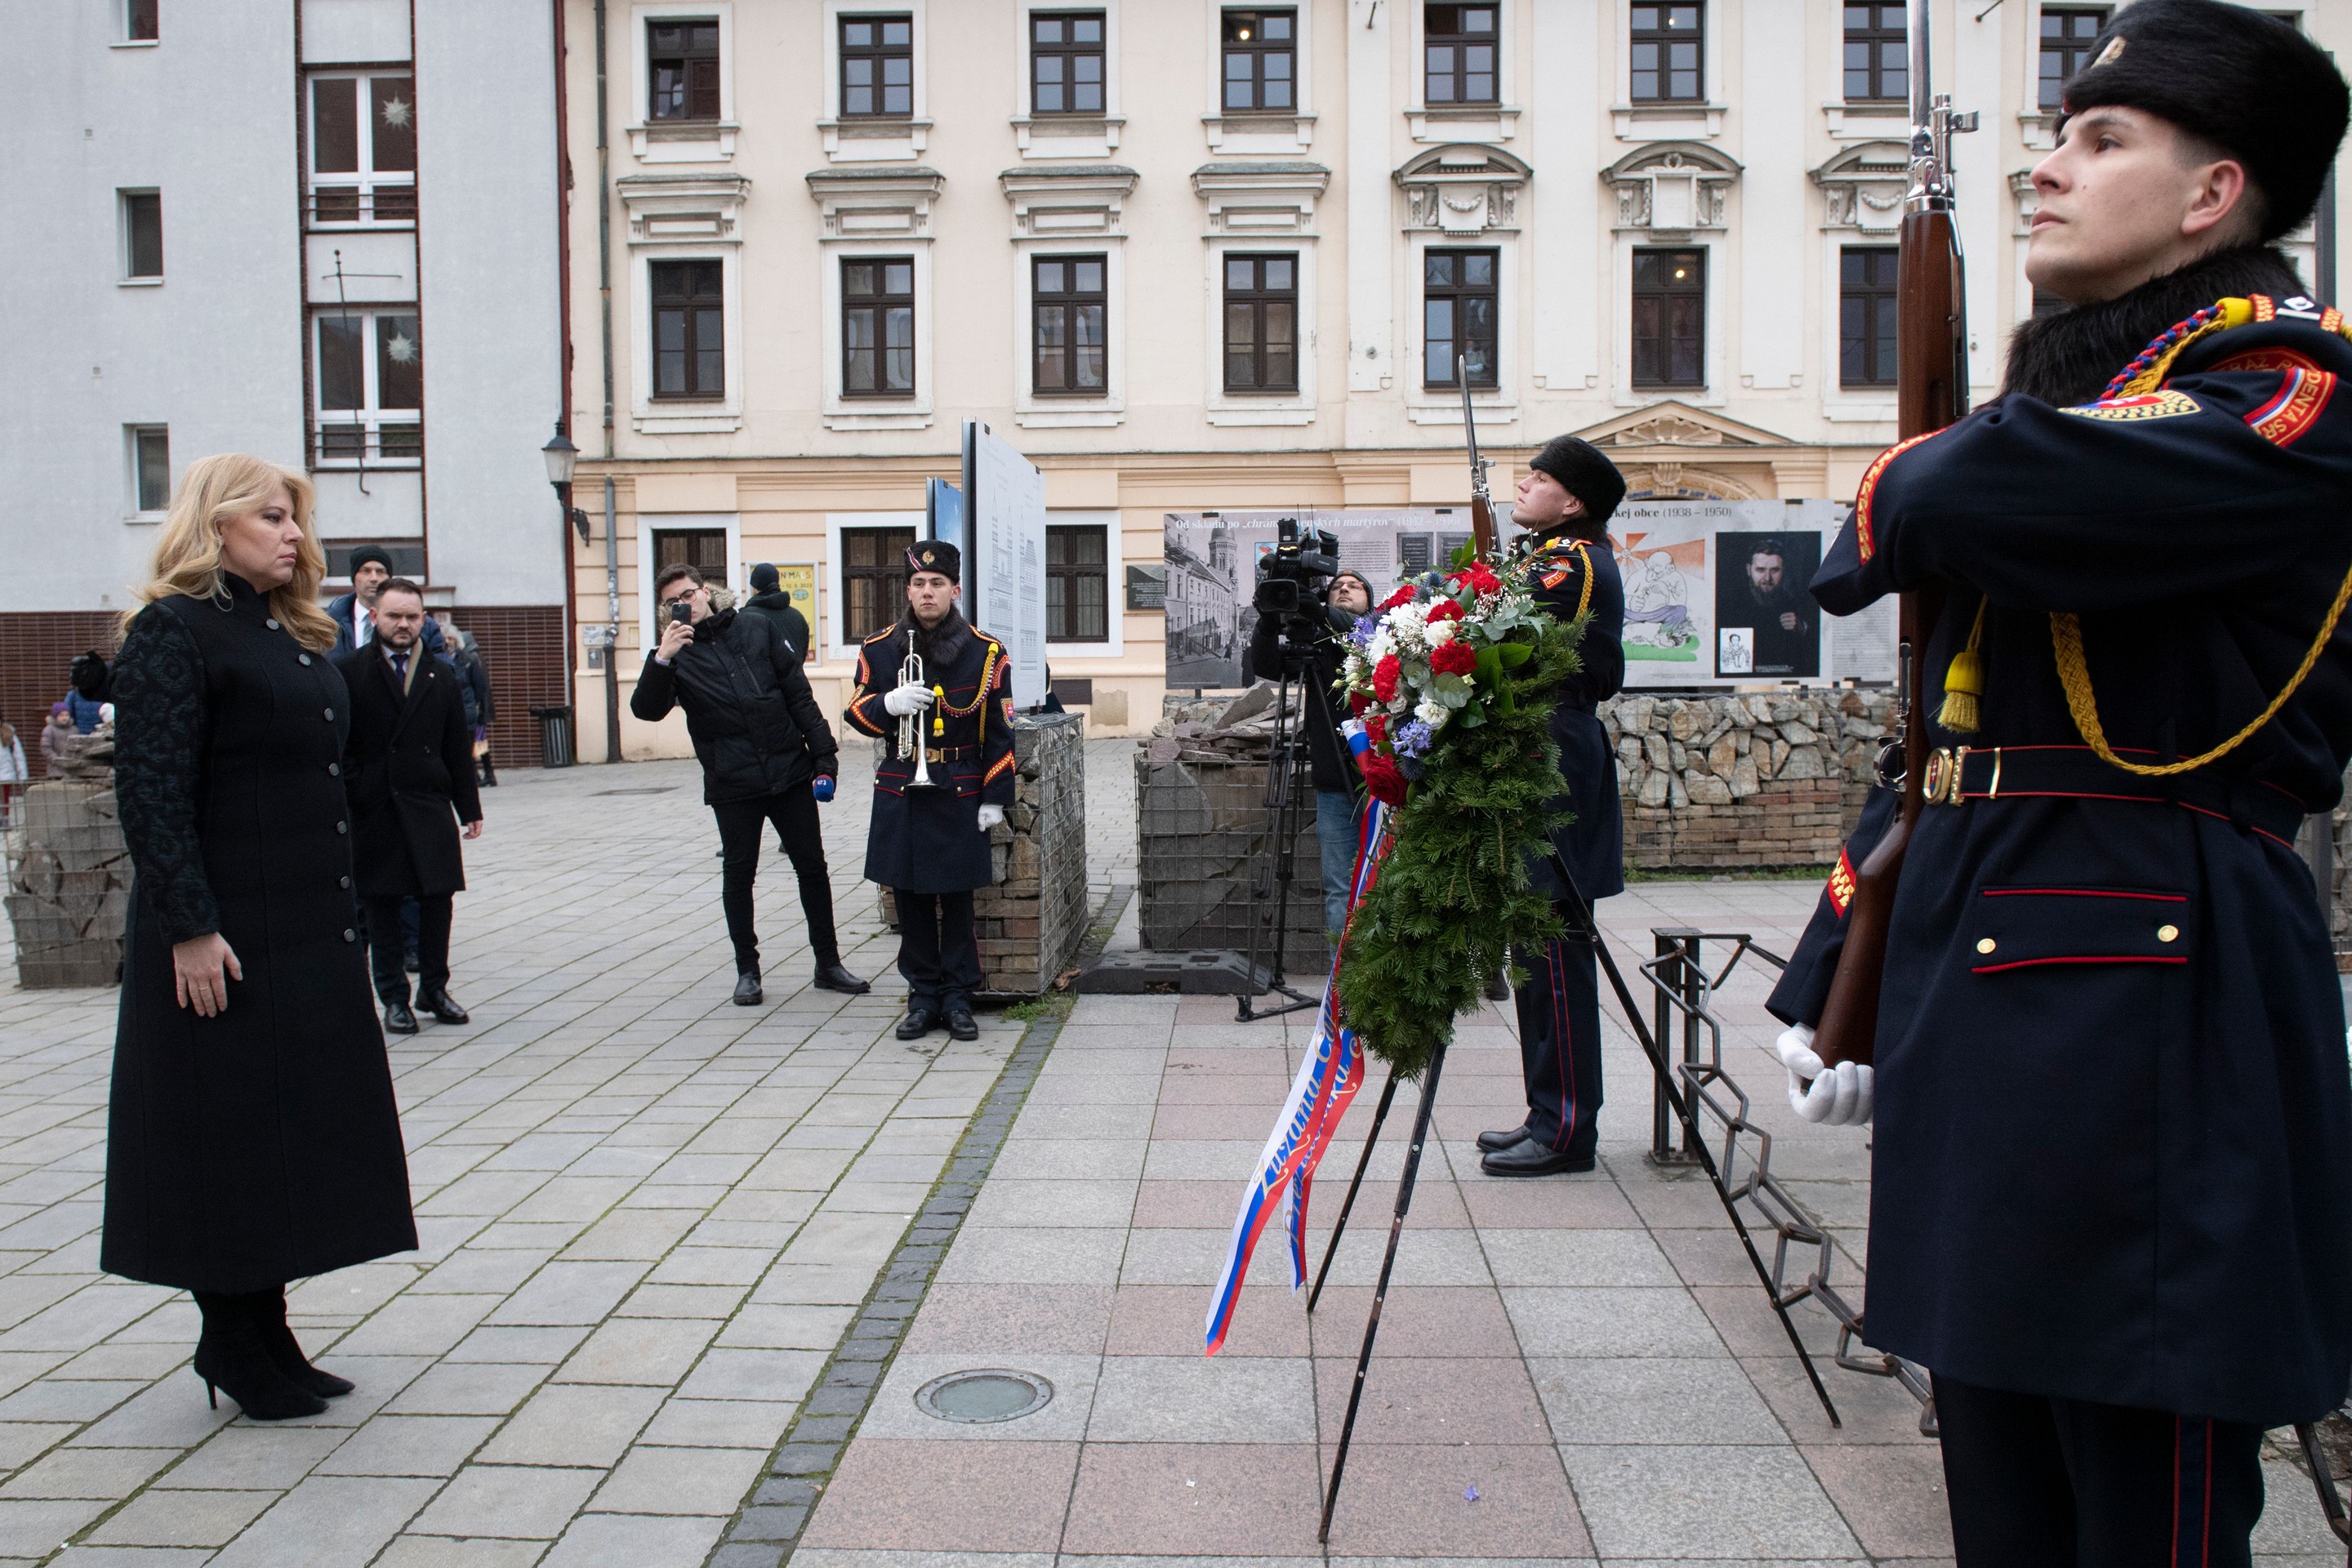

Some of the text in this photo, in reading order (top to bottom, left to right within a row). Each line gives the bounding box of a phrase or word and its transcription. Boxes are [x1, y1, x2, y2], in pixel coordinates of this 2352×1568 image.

[2261, 418, 2287, 439] SR
[1615, 508, 1631, 519] kej
[1634, 508, 1659, 517] obce
[1663, 507, 1691, 518] (1938
[1704, 507, 1732, 518] 1950)
[1175, 519, 1187, 529] Od
[1192, 519, 1225, 529] skladu
[1227, 521, 1240, 530] po
[781, 571, 811, 579] NIMALS
[1253, 1076, 1323, 1200] Zuzana
